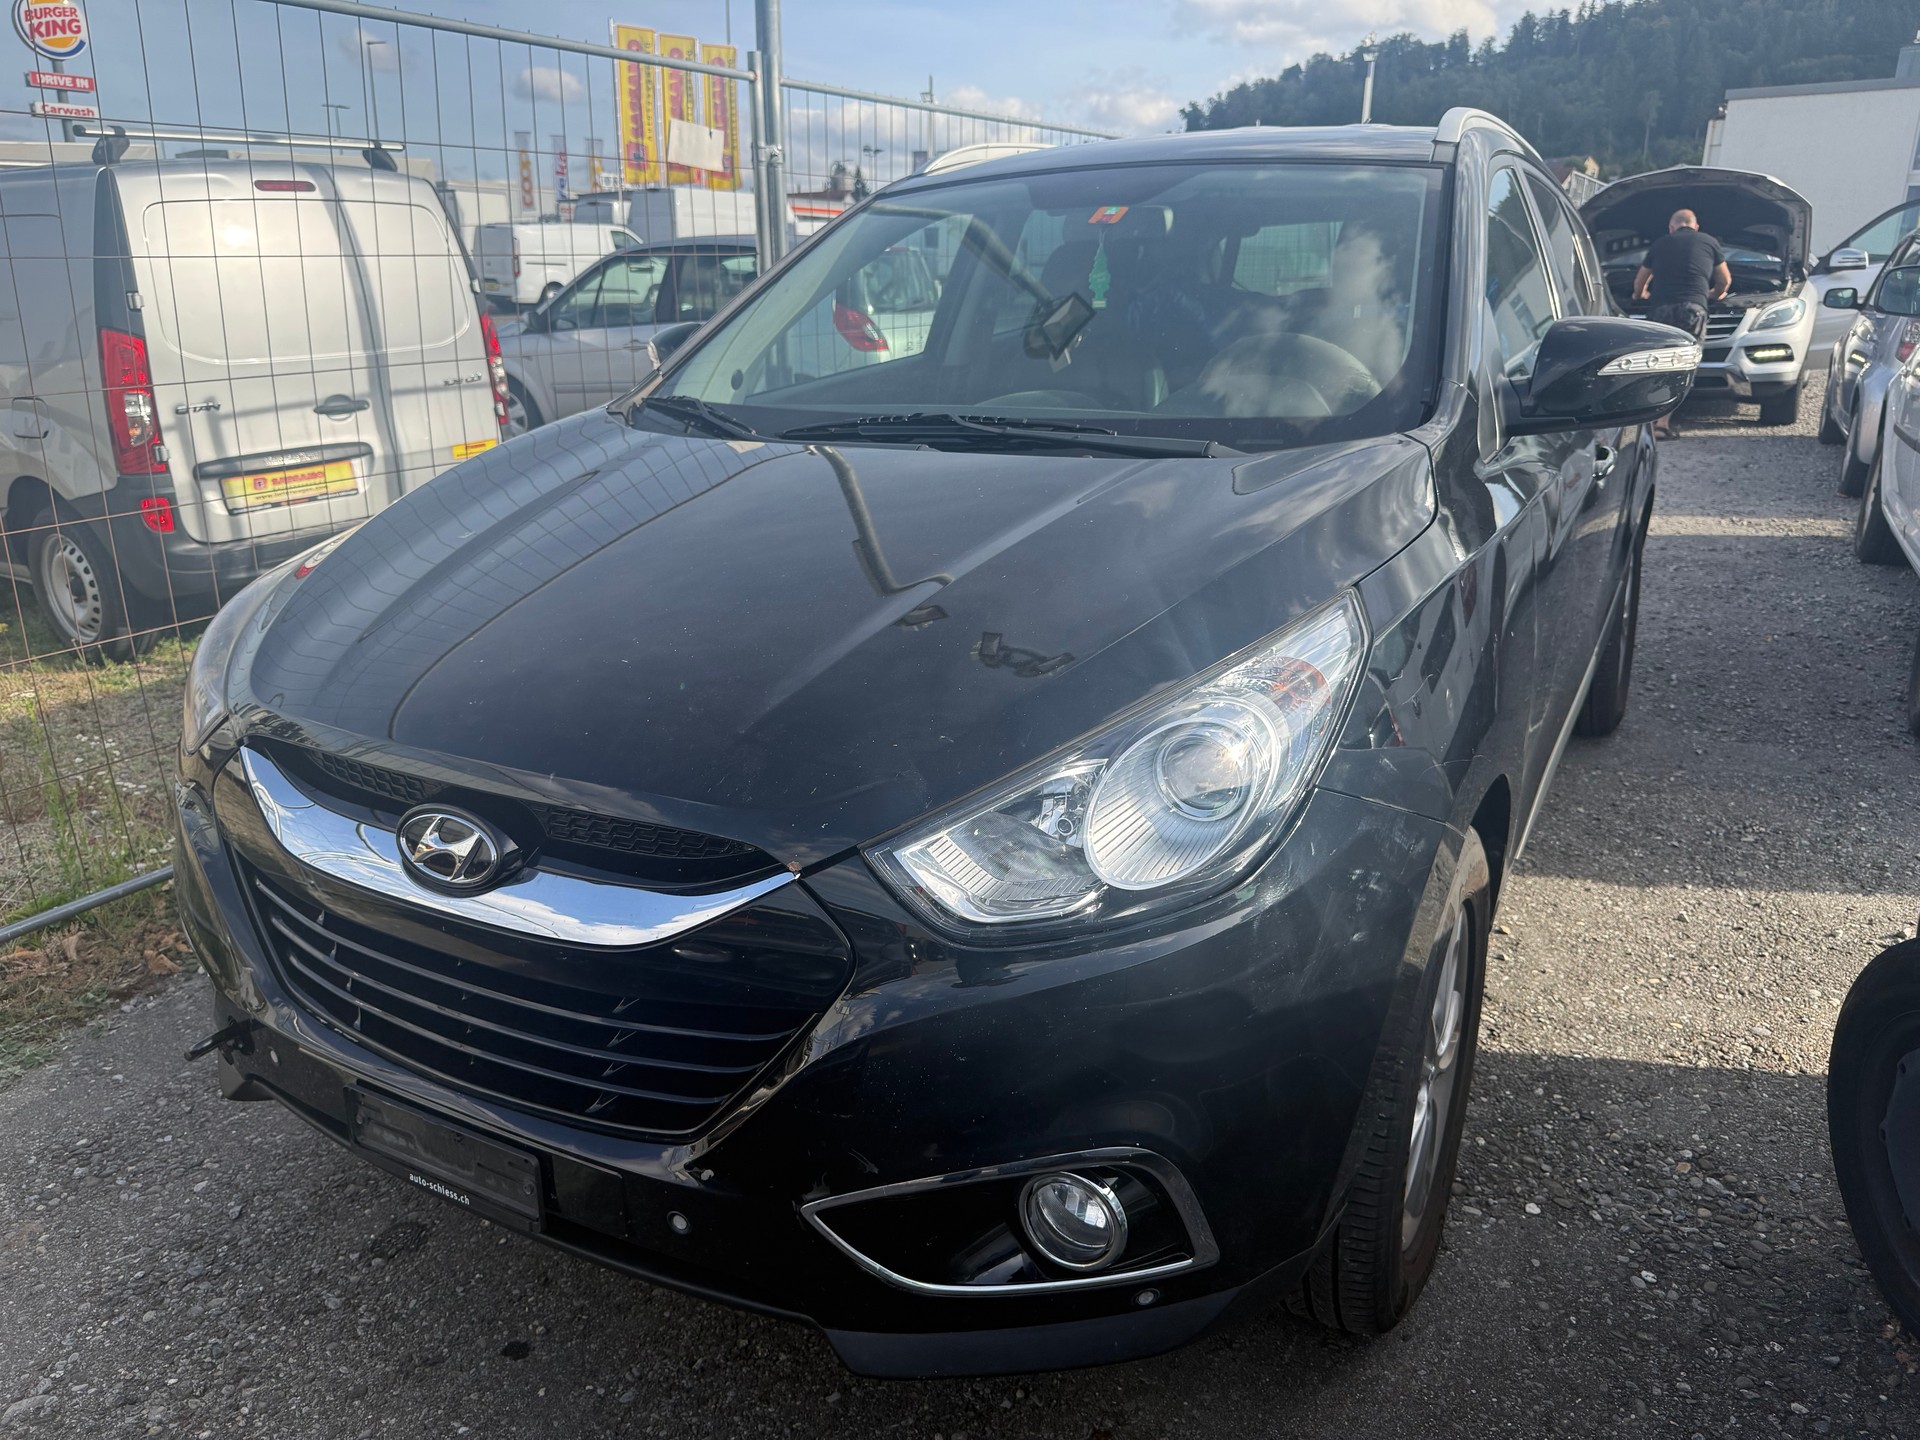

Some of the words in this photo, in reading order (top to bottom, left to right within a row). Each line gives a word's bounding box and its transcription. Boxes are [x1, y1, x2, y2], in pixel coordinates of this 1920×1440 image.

[24, 6, 78, 22] BURGER
[29, 19, 82, 40] KING
[36, 73, 74, 88] DRIVE
[76, 77, 90, 89] IN
[40, 103, 95, 118] Carwash
[409, 1173, 470, 1206] auto-schiess.ch
